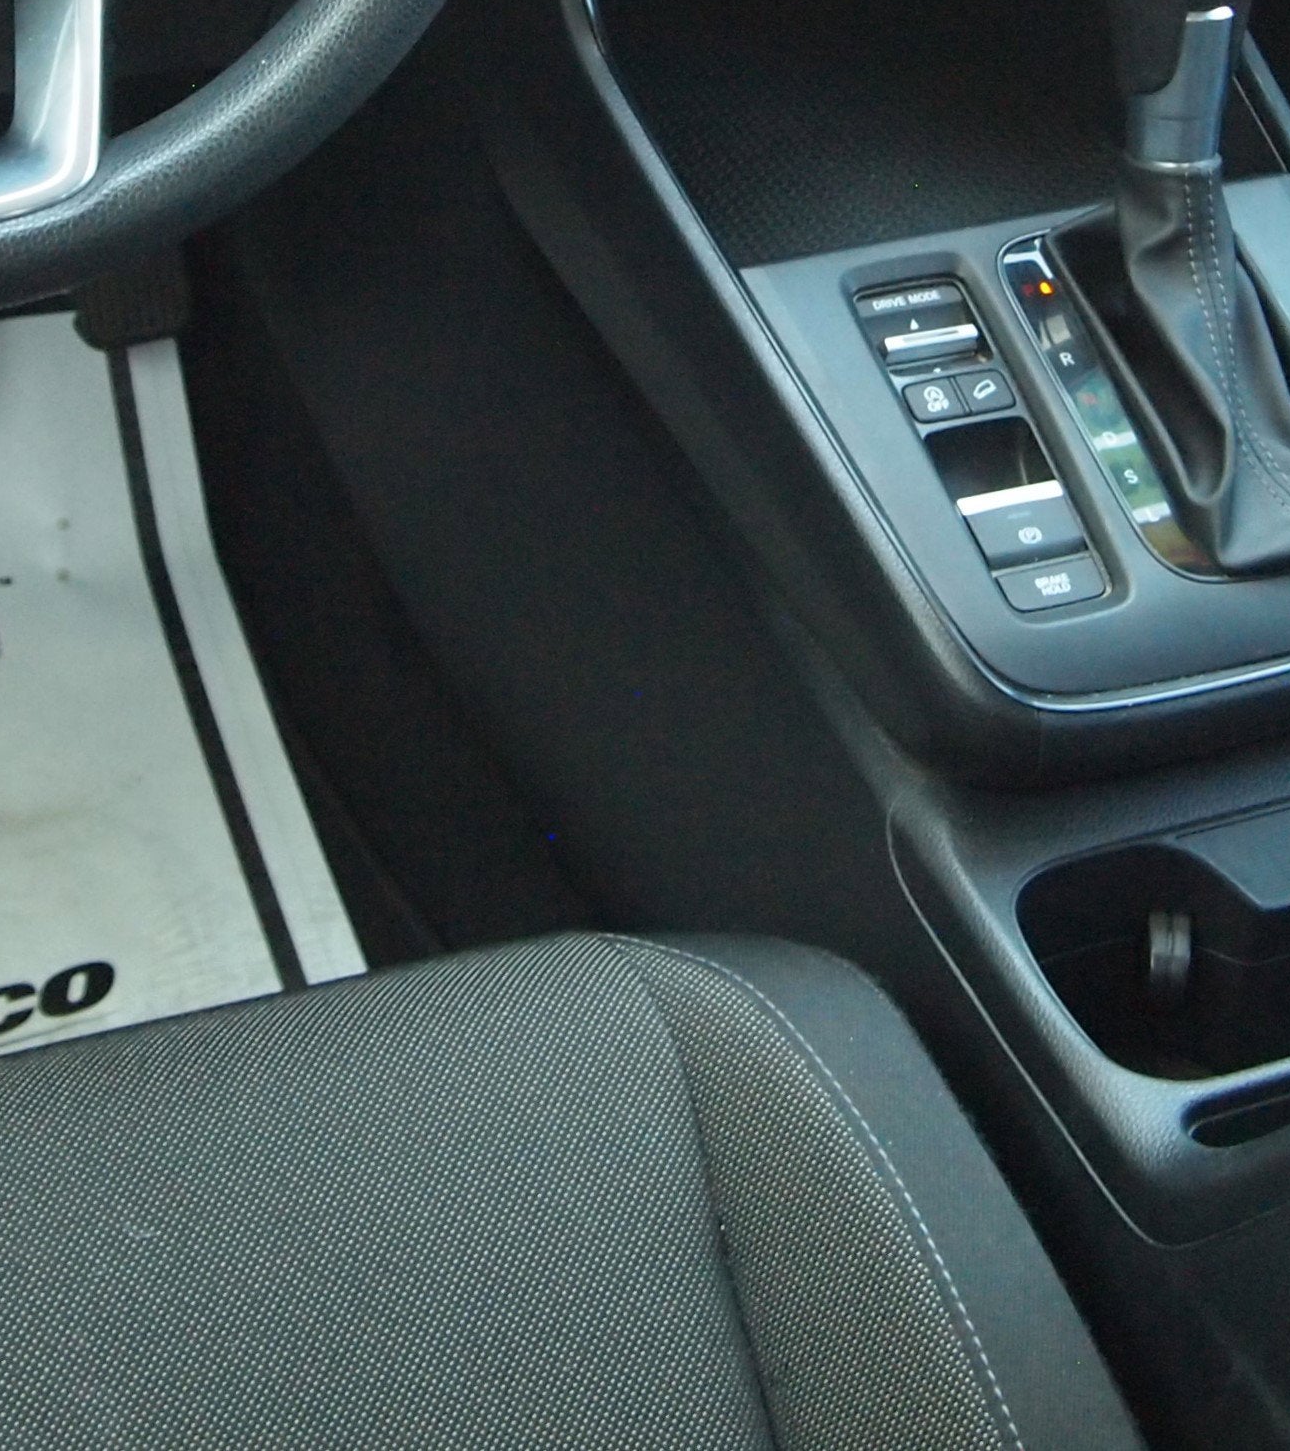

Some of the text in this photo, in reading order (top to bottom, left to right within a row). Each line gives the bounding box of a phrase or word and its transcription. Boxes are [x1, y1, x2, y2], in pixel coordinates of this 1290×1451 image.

[872, 291, 941, 311] DRIVE MODE
[1059, 352, 1075, 366] R
[1123, 468, 1139, 484] S
[1040, 582, 1071, 596] HOLD
